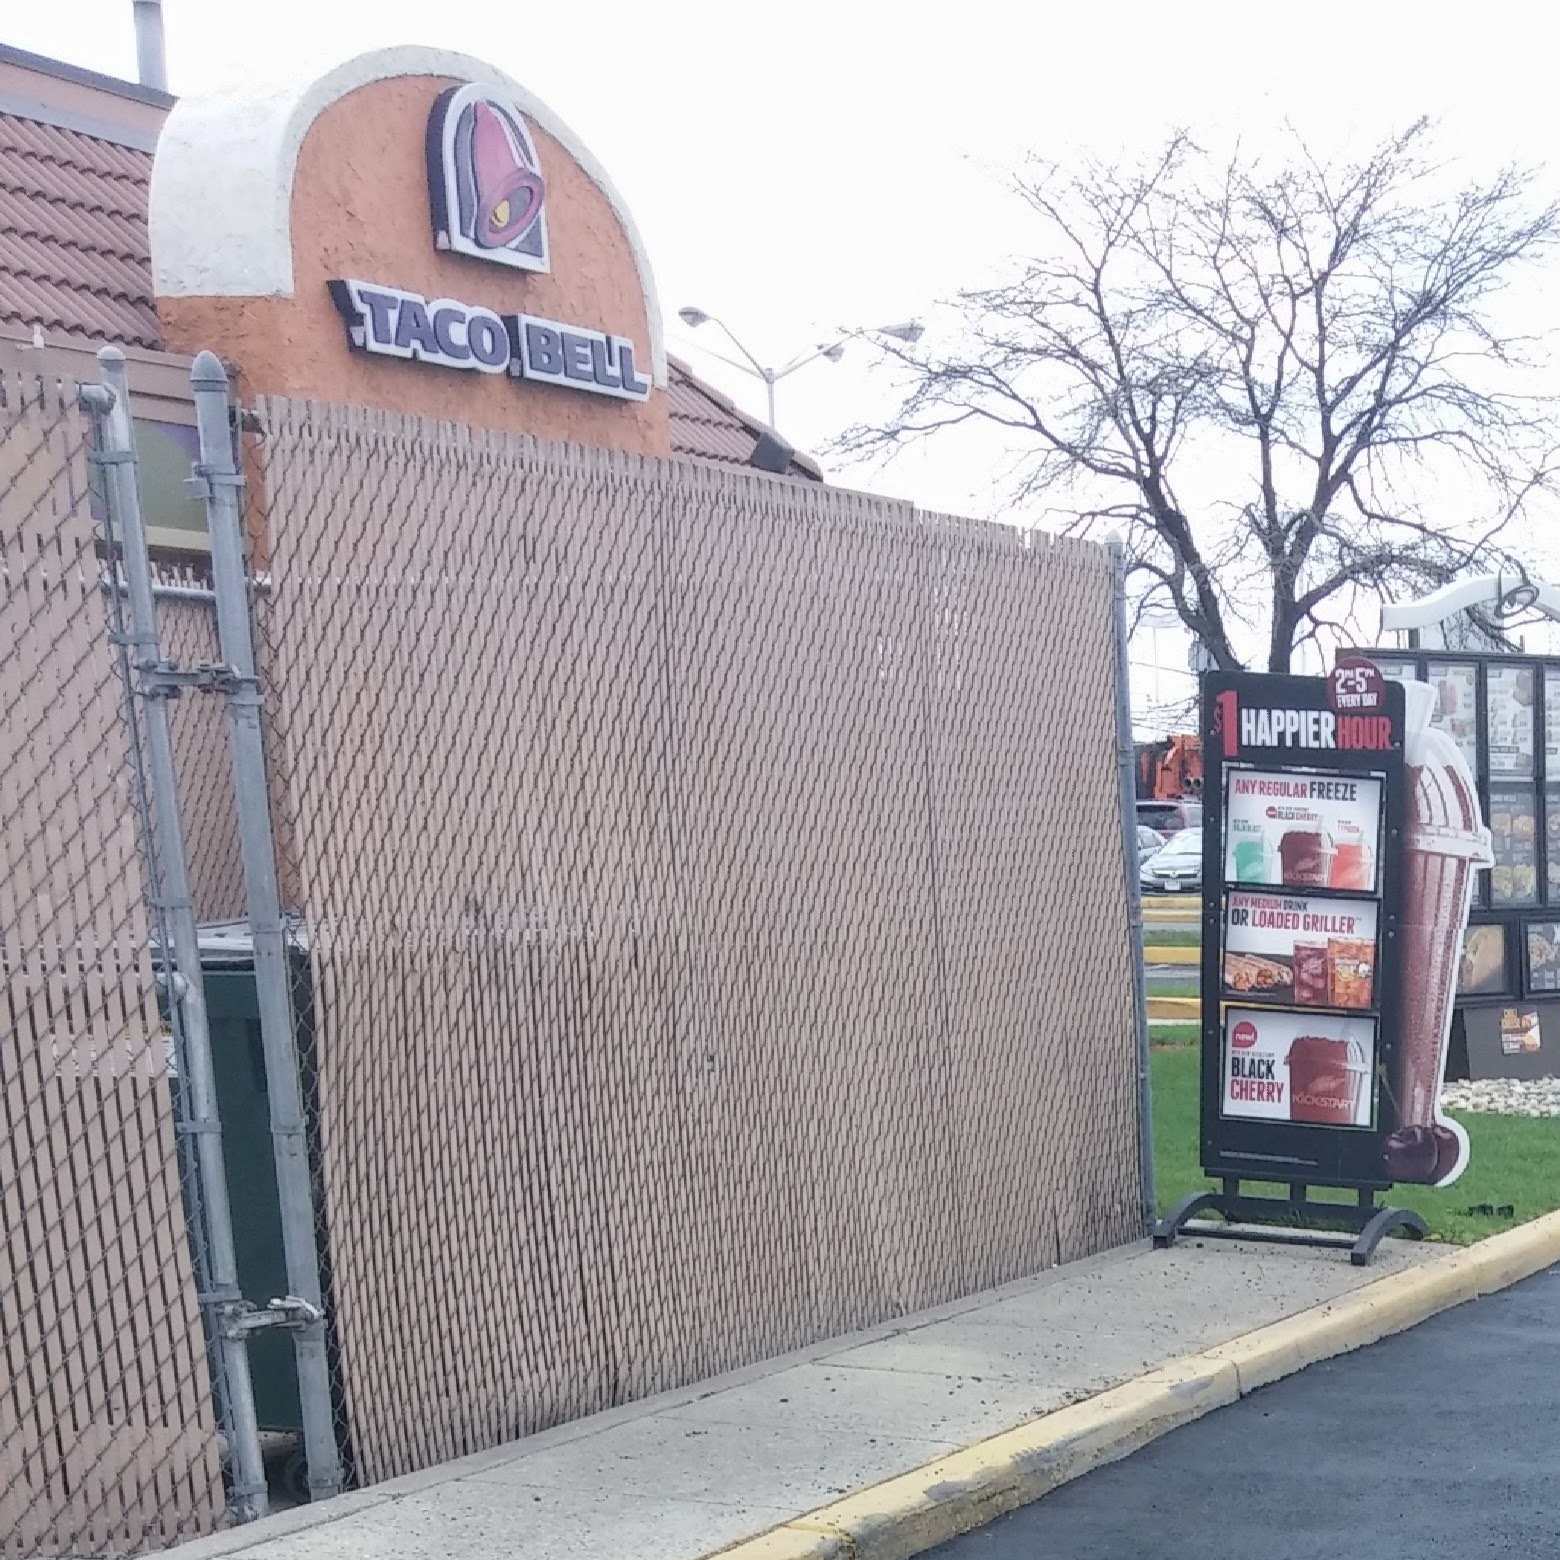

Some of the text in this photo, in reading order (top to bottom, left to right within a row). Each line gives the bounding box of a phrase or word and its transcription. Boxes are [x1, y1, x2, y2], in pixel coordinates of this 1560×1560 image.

[357, 289, 648, 394] TACO BELL
[1362, 692, 1378, 706] DAY
[1241, 708, 1336, 749] HAPPIER
[1337, 715, 1392, 750] HOUR
[1235, 779, 1357, 801] ANY REGULAR FREEZE
[1231, 896, 1308, 912] ANY MEDIUM DRINK
[1231, 908, 1355, 934] OR LOADED GRILLER
[1231, 1056, 1276, 1080] BLACK
[1230, 1079, 1284, 1103] CHERRY
